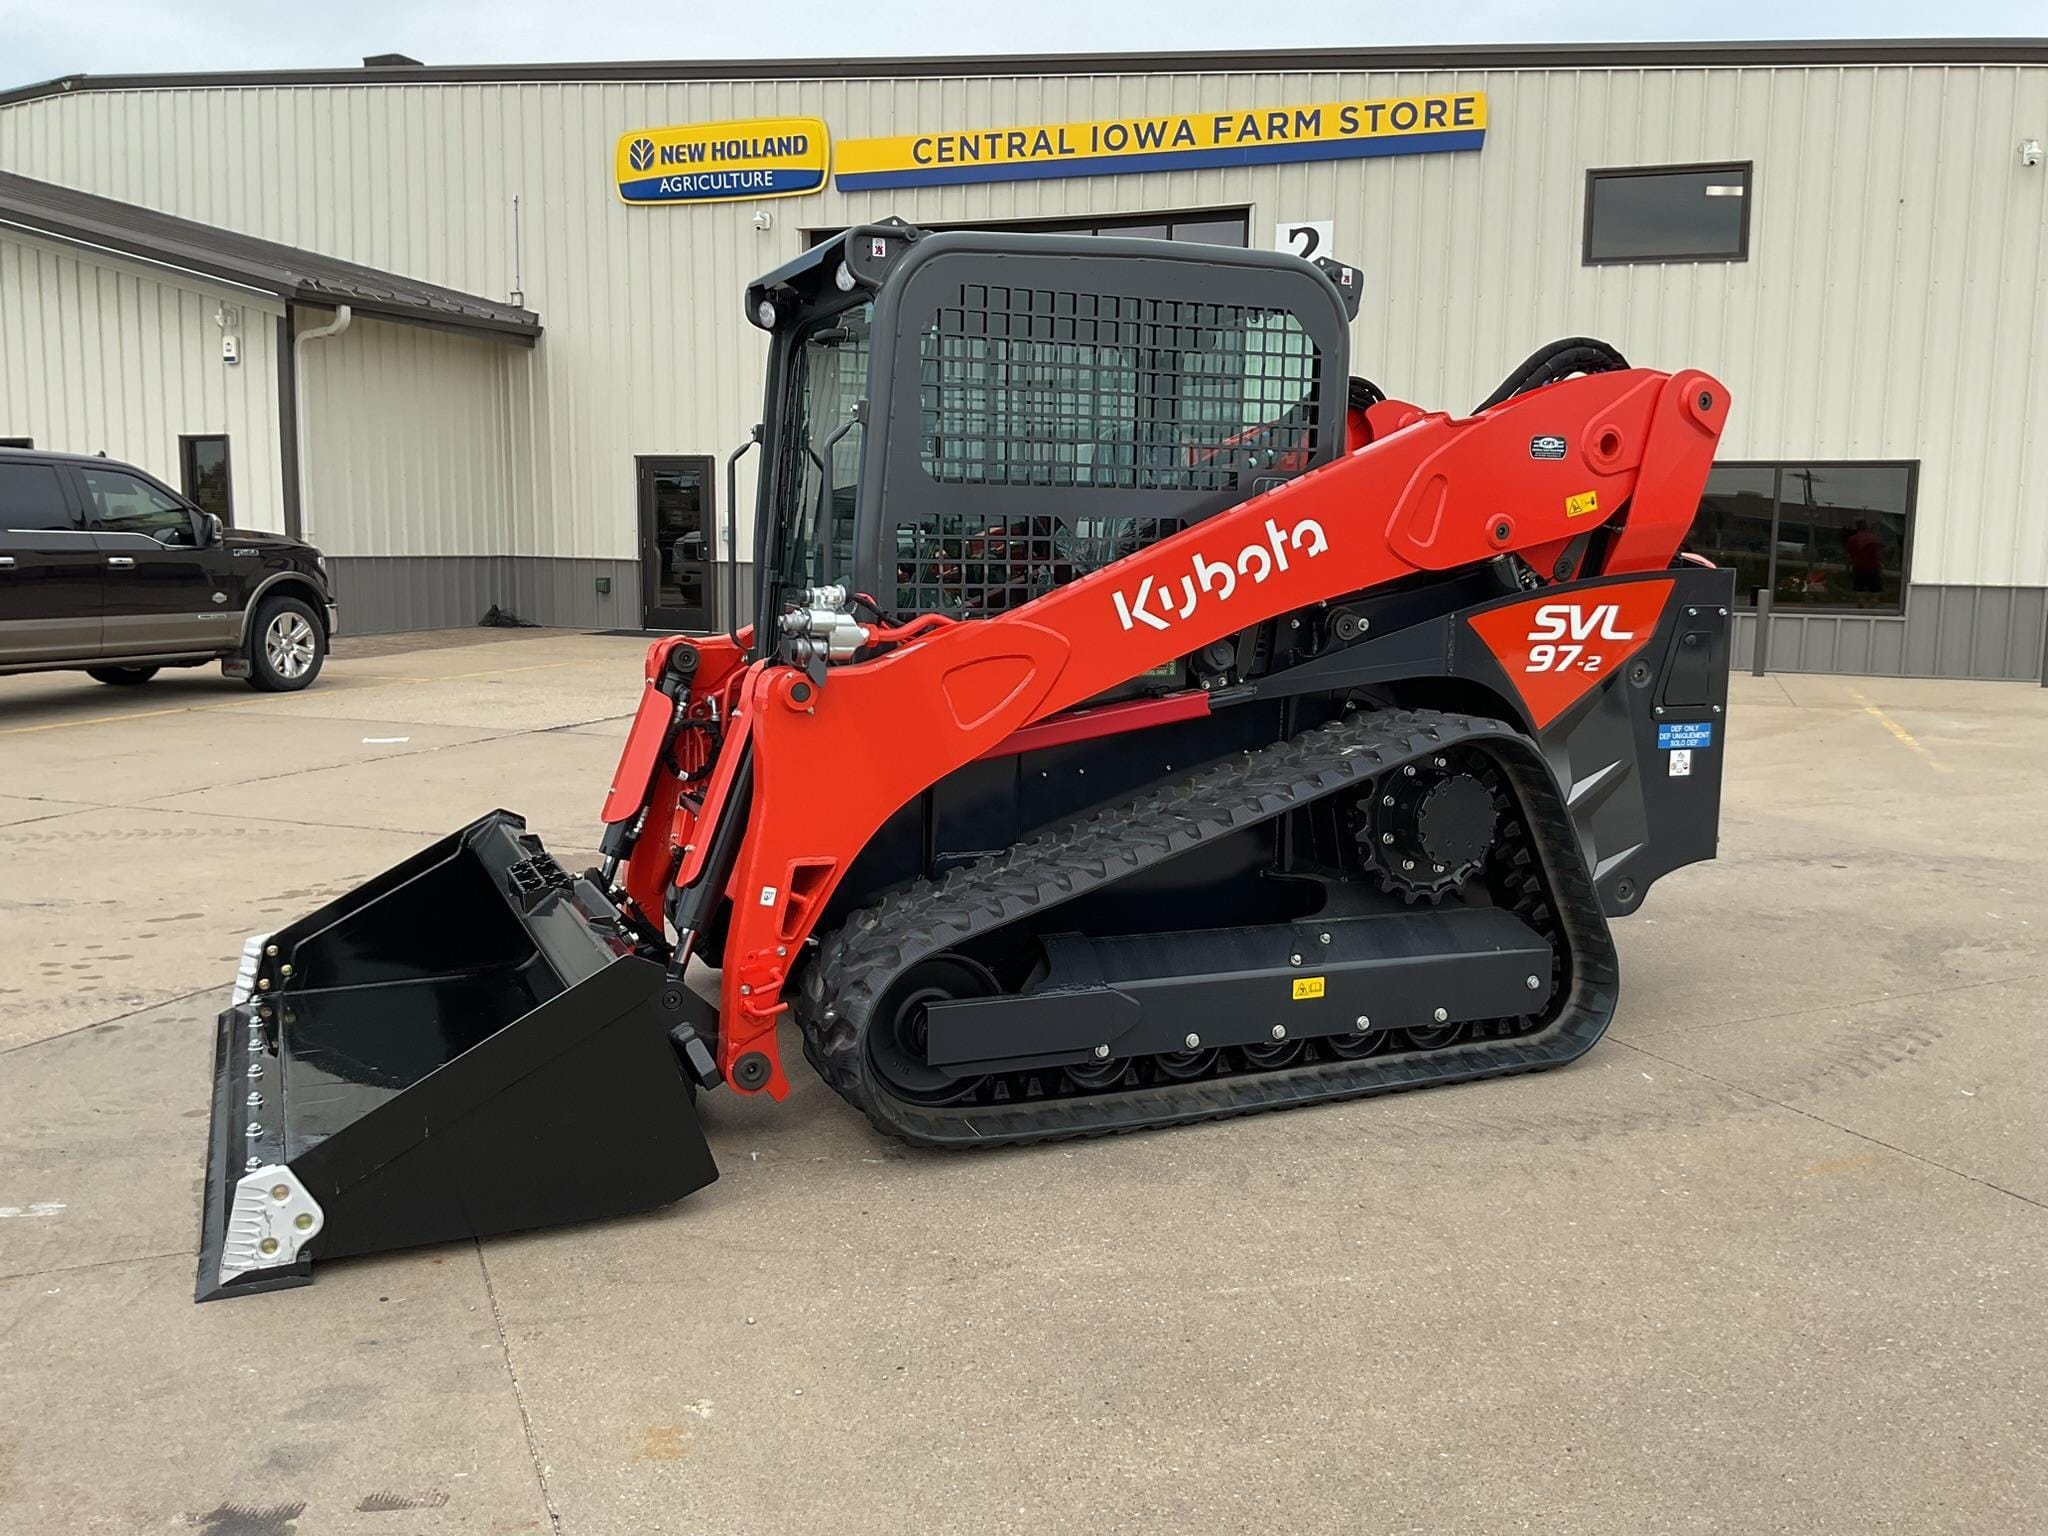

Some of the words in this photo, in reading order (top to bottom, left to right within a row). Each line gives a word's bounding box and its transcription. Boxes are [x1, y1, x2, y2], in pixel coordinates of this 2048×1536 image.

[912, 127, 1076, 164] CENTRAL
[1091, 118, 1196, 154] IOWA
[1212, 109, 1321, 144] FARM
[1339, 97, 1475, 135] STORE
[660, 143, 700, 164] NEW
[711, 134, 808, 160] HOLLAND
[659, 170, 774, 194] AGRICULTURE
[1288, 226, 1320, 260] 2
[1111, 518, 1329, 632] Kubota
[1526, 604, 1635, 641] SVL
[1525, 644, 1603, 673] 97-2
